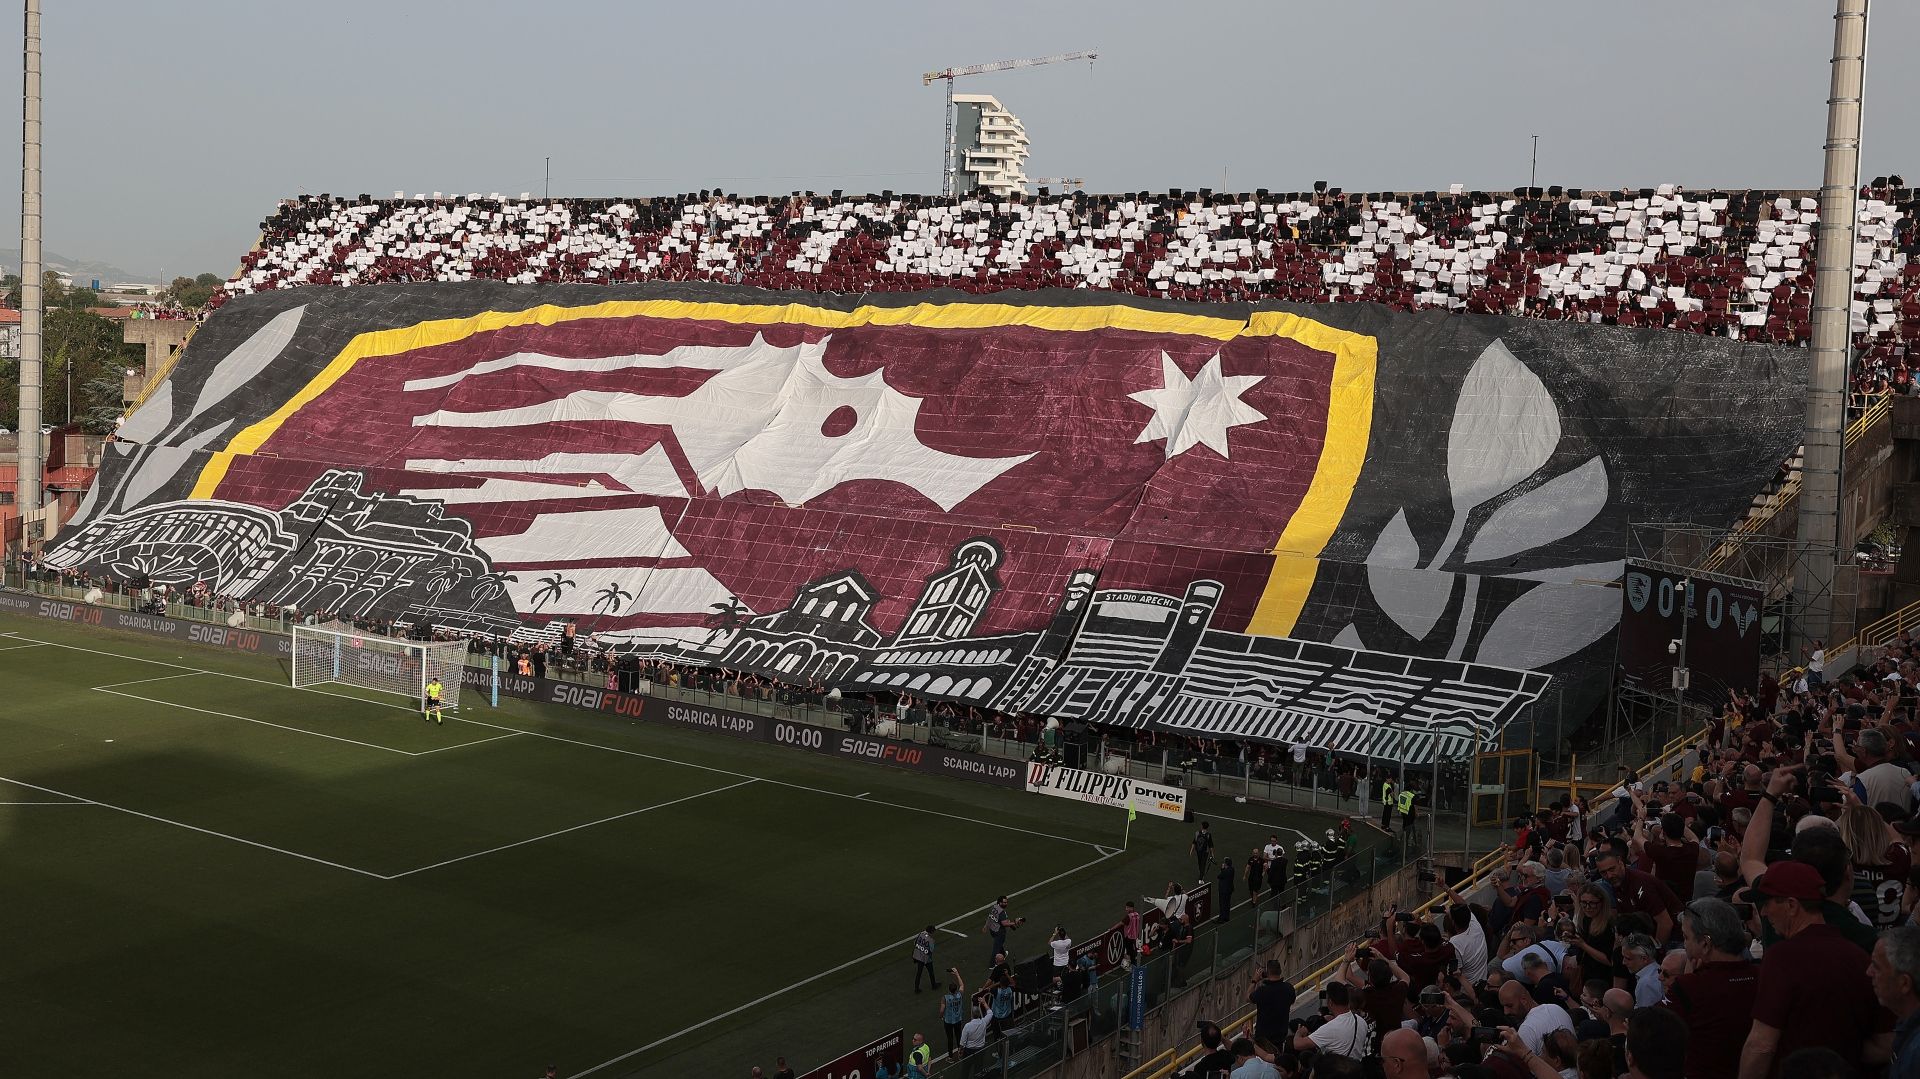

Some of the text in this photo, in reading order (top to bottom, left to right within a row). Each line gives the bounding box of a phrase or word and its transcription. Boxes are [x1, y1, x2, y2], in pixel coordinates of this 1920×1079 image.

[1105, 593, 1174, 607] STADIO ARECHI
[1658, 577, 1674, 618] 0
[1706, 587, 1723, 629] 0
[118, 614, 176, 634] SCARICA L'APP
[505, 676, 535, 694] L'APP
[667, 706, 754, 733] SCARICA L'APP
[775, 723, 822, 749] 00:00
[943, 757, 1016, 779] SCARICA L'APP
[1028, 764, 1133, 801] DE FILIPPIS
[866, 1036, 900, 1058] TOP PARTNER
